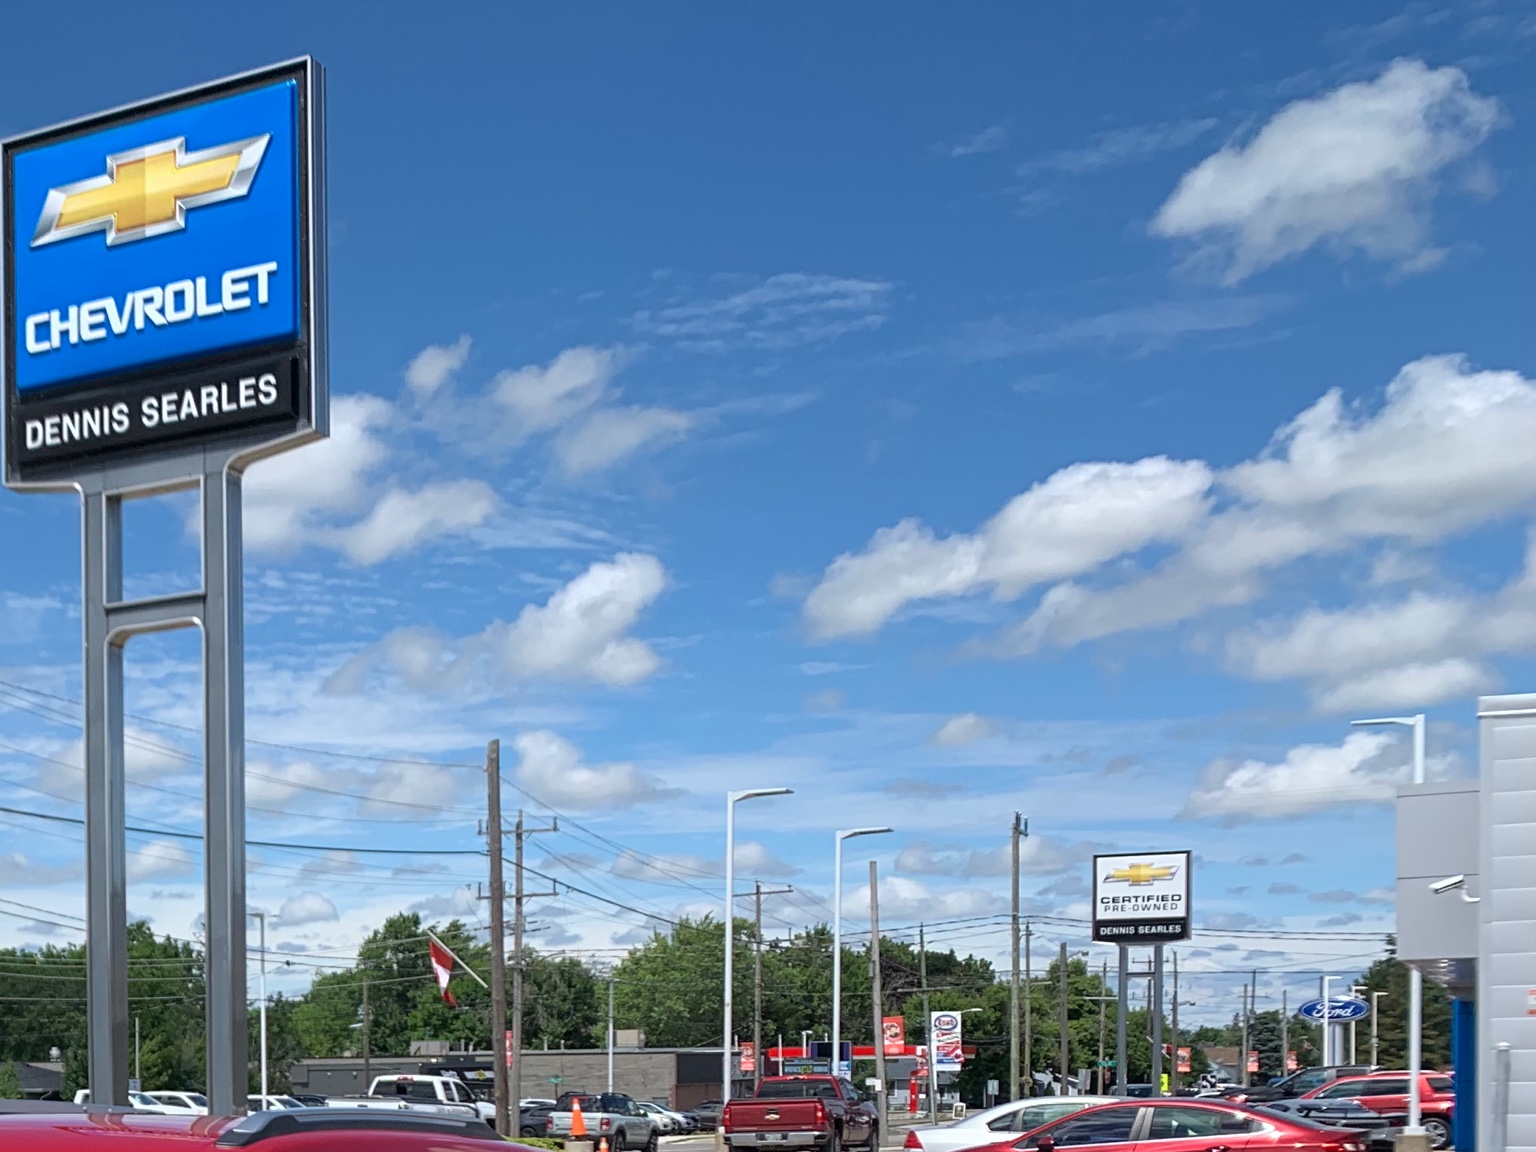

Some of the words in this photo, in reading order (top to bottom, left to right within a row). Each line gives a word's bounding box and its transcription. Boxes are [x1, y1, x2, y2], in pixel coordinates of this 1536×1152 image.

[25, 260, 279, 355] CHEVROLET
[25, 400, 131, 450] DENNIS
[141, 373, 279, 428] SEARLES
[1100, 894, 1182, 904] CERTIFIED
[1104, 903, 1178, 912] PRE-OWNED
[1100, 926, 1135, 935] DENNIS
[1138, 925, 1181, 934] SEARLES
[1312, 1002, 1356, 1018] Ford
